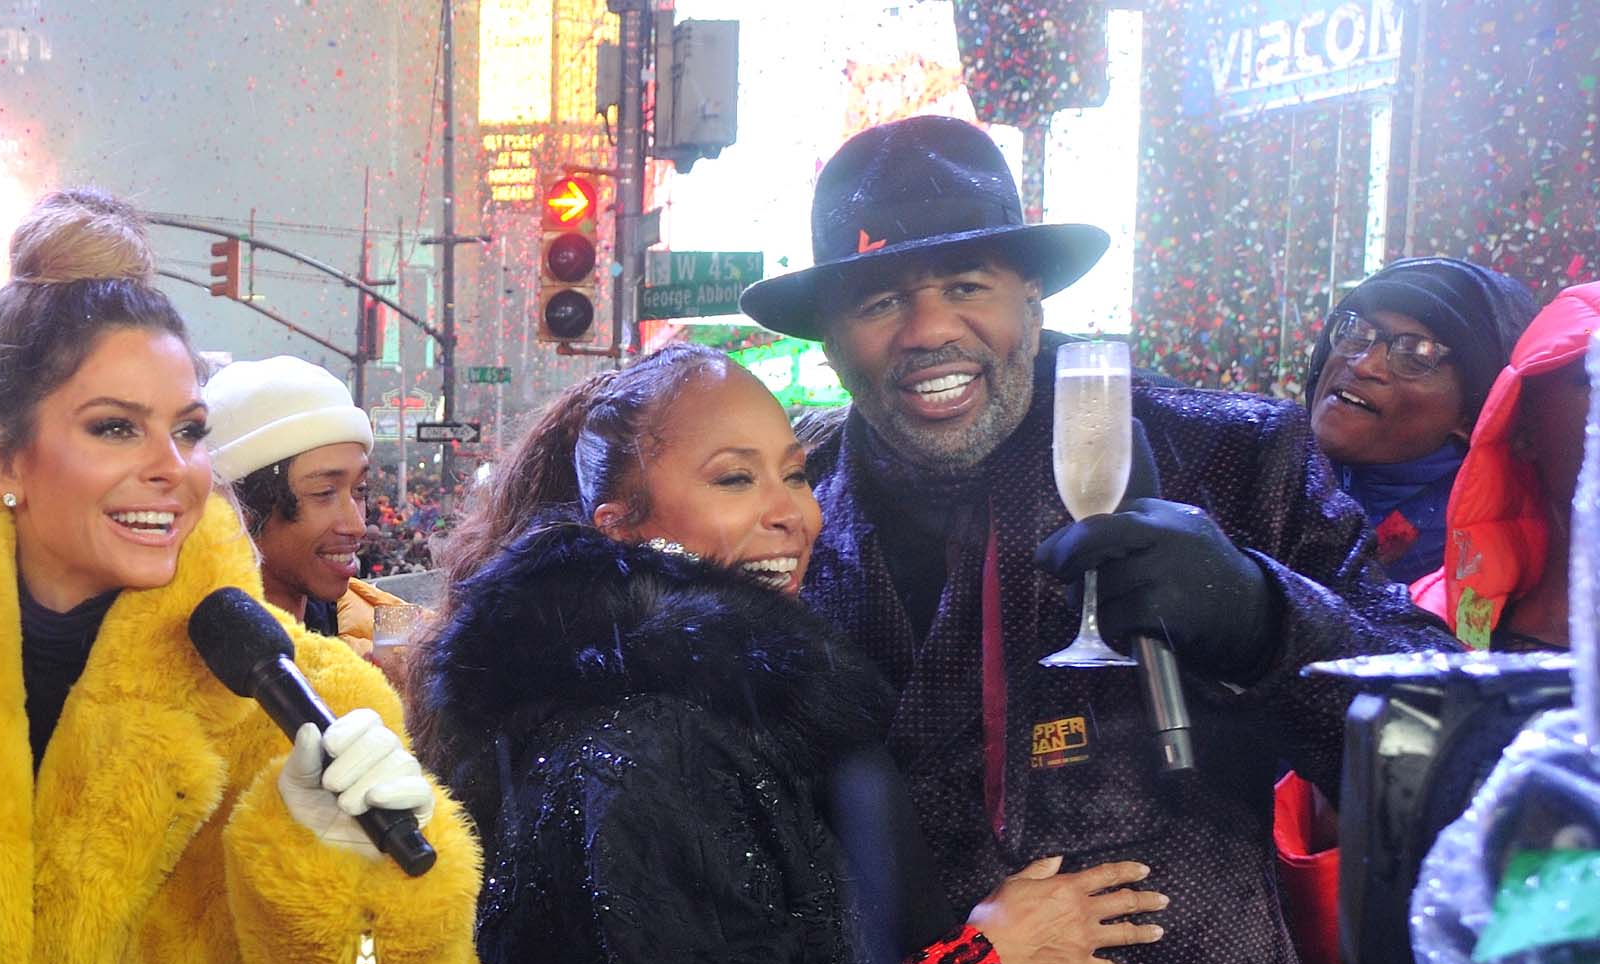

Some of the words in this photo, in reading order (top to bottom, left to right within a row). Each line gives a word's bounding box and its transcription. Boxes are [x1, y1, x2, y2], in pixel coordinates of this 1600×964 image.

[677, 254, 697, 280] W
[709, 252, 735, 280] 45
[643, 287, 692, 310] George
